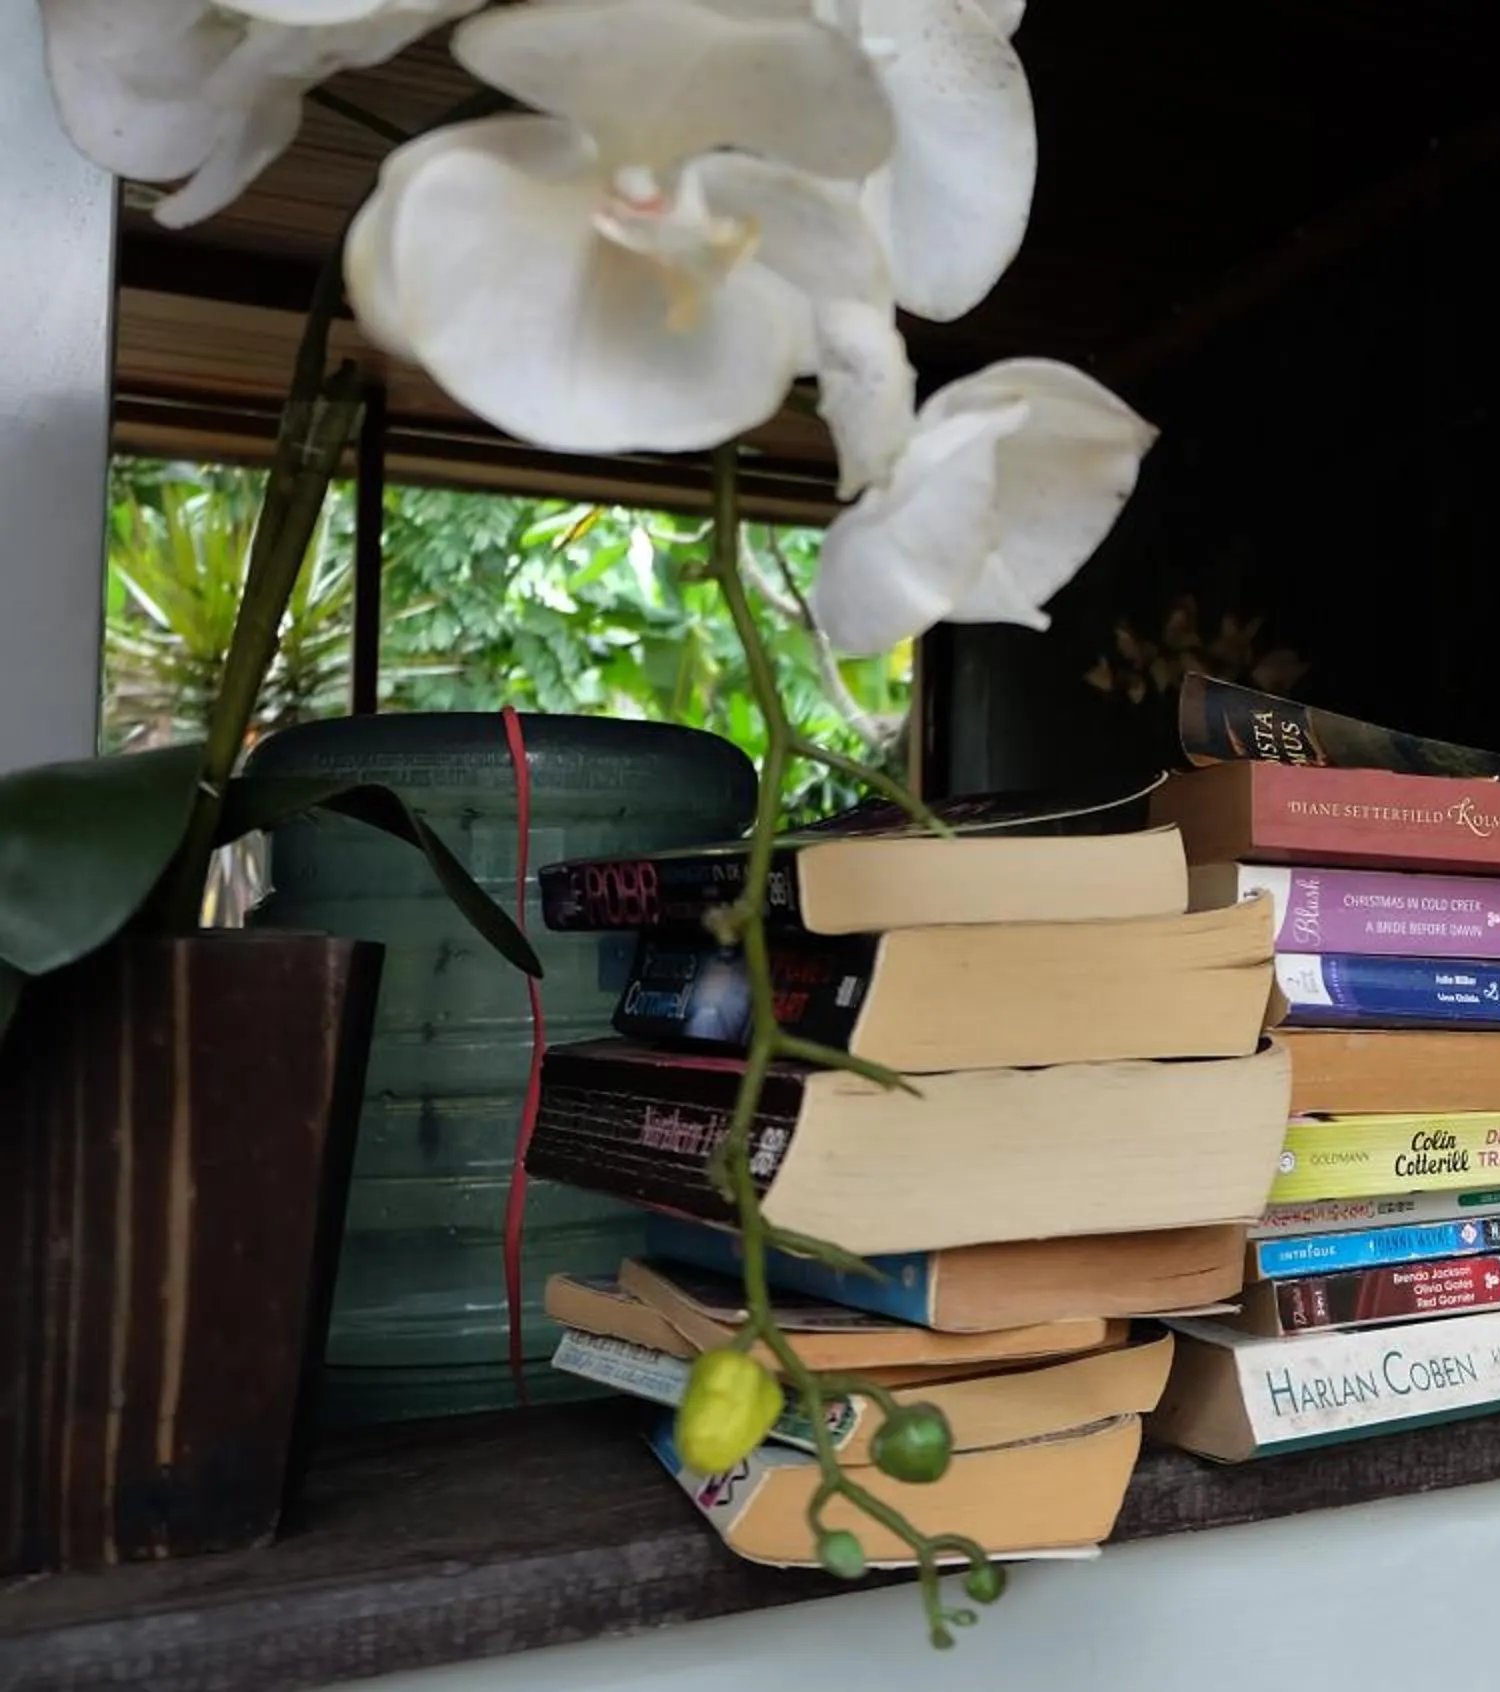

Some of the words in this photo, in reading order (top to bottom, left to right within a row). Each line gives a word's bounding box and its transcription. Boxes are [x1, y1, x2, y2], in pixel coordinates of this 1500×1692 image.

[1288, 801, 1339, 817] DIANE
[1343, 804, 1444, 823] SETTERFIELD
[1344, 894, 1403, 909] CHRISTMAS
[1407, 896, 1418, 910] IN
[1421, 897, 1448, 911] COLD
[1451, 899, 1483, 913] CREEK
[1376, 922, 1406, 936] BRIDE
[1410, 922, 1446, 937] BEFORE
[1450, 924, 1483, 938] DAWN
[1411, 1129, 1457, 1151] Colin
[1395, 1147, 1471, 1177] Cotterill
[1393, 1270, 1429, 1285] Brenda
[1431, 1265, 1472, 1281] Jackson
[1413, 1281, 1444, 1296] Olivia
[1445, 1278, 1473, 1292] Gates
[1265, 1367, 1379, 1418] HARLAN
[1382, 1350, 1479, 1397] COBEN
